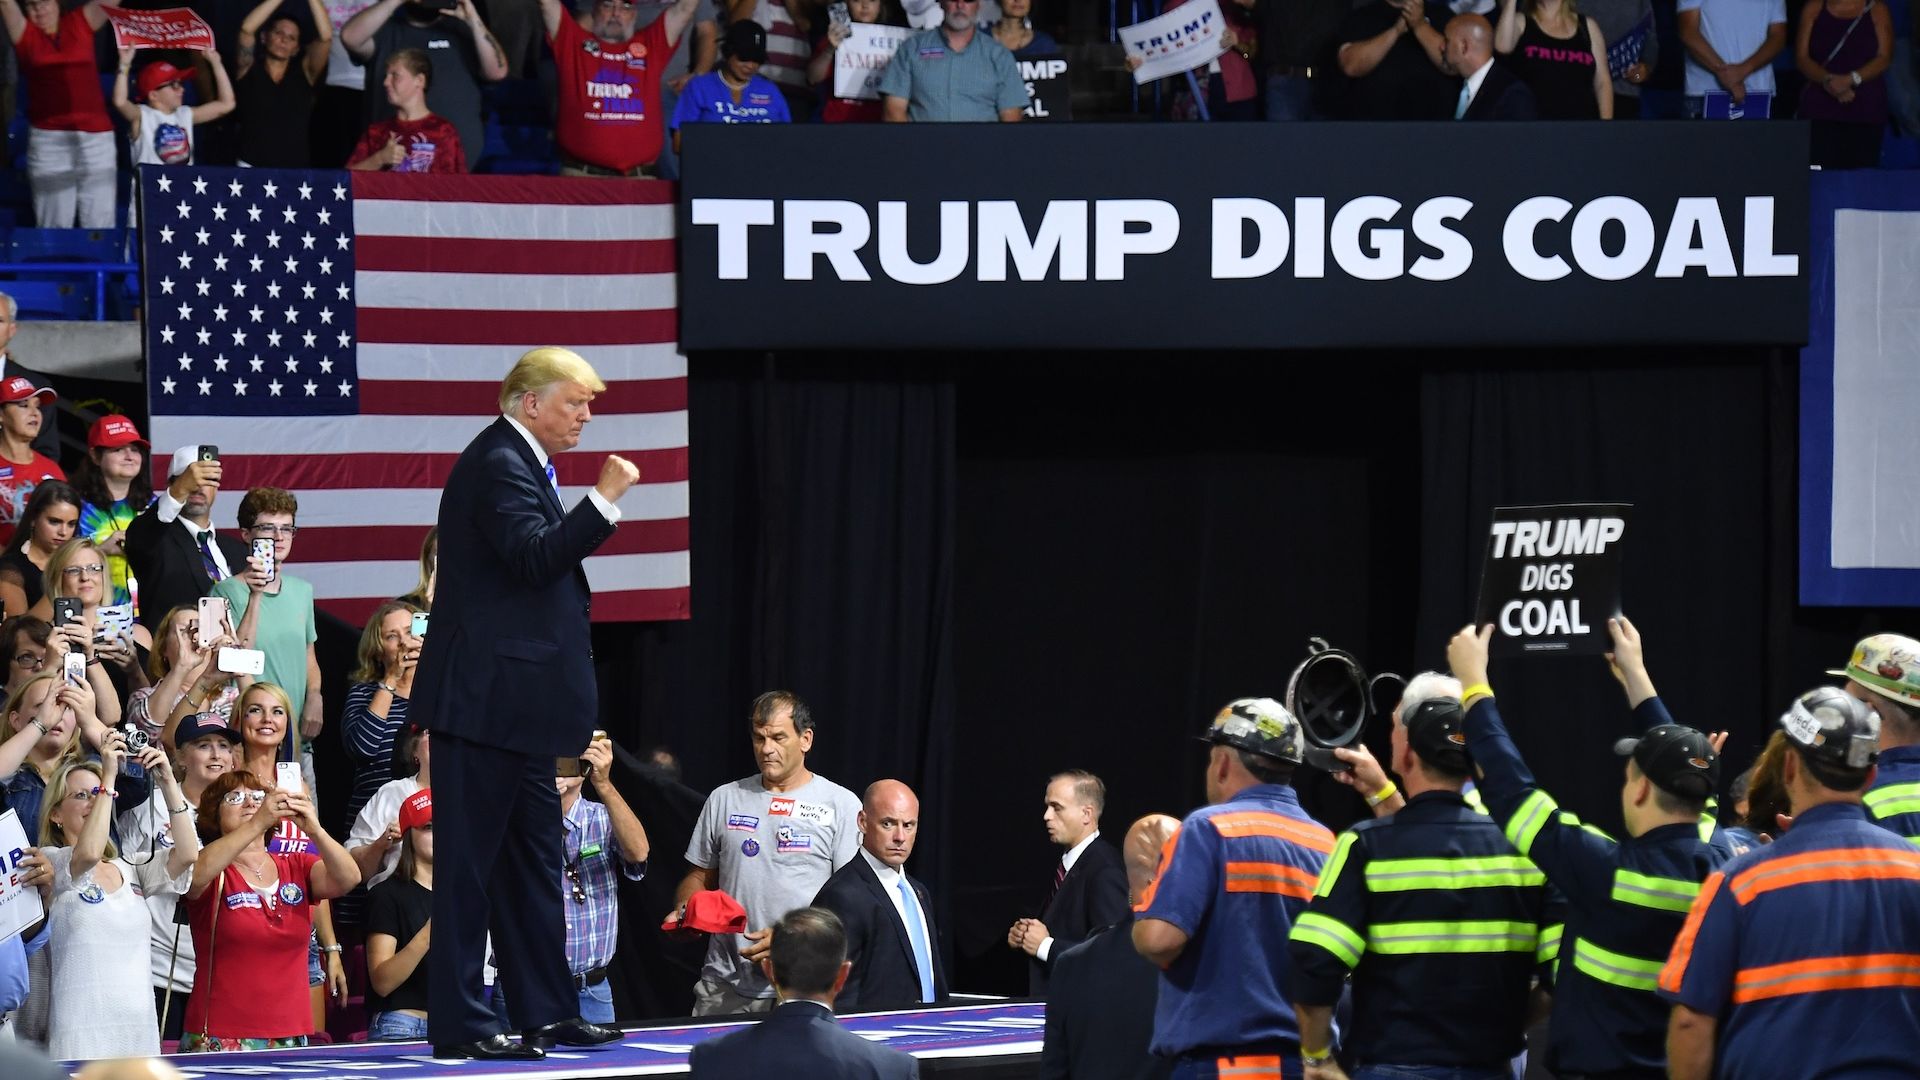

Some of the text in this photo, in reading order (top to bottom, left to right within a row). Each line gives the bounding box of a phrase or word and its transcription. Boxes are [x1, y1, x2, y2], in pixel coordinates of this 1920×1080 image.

[1134, 11, 1212, 50] TRUMP
[1525, 45, 1593, 65] TRUMP
[586, 81, 633, 99] TRUMP
[692, 196, 1800, 285] TRUMP DIGS COAL
[1490, 517, 1626, 559] TRUMP
[1520, 564, 1574, 592] DIGS
[1500, 599, 1591, 637] COAL
[280, 839, 309, 854] THE
